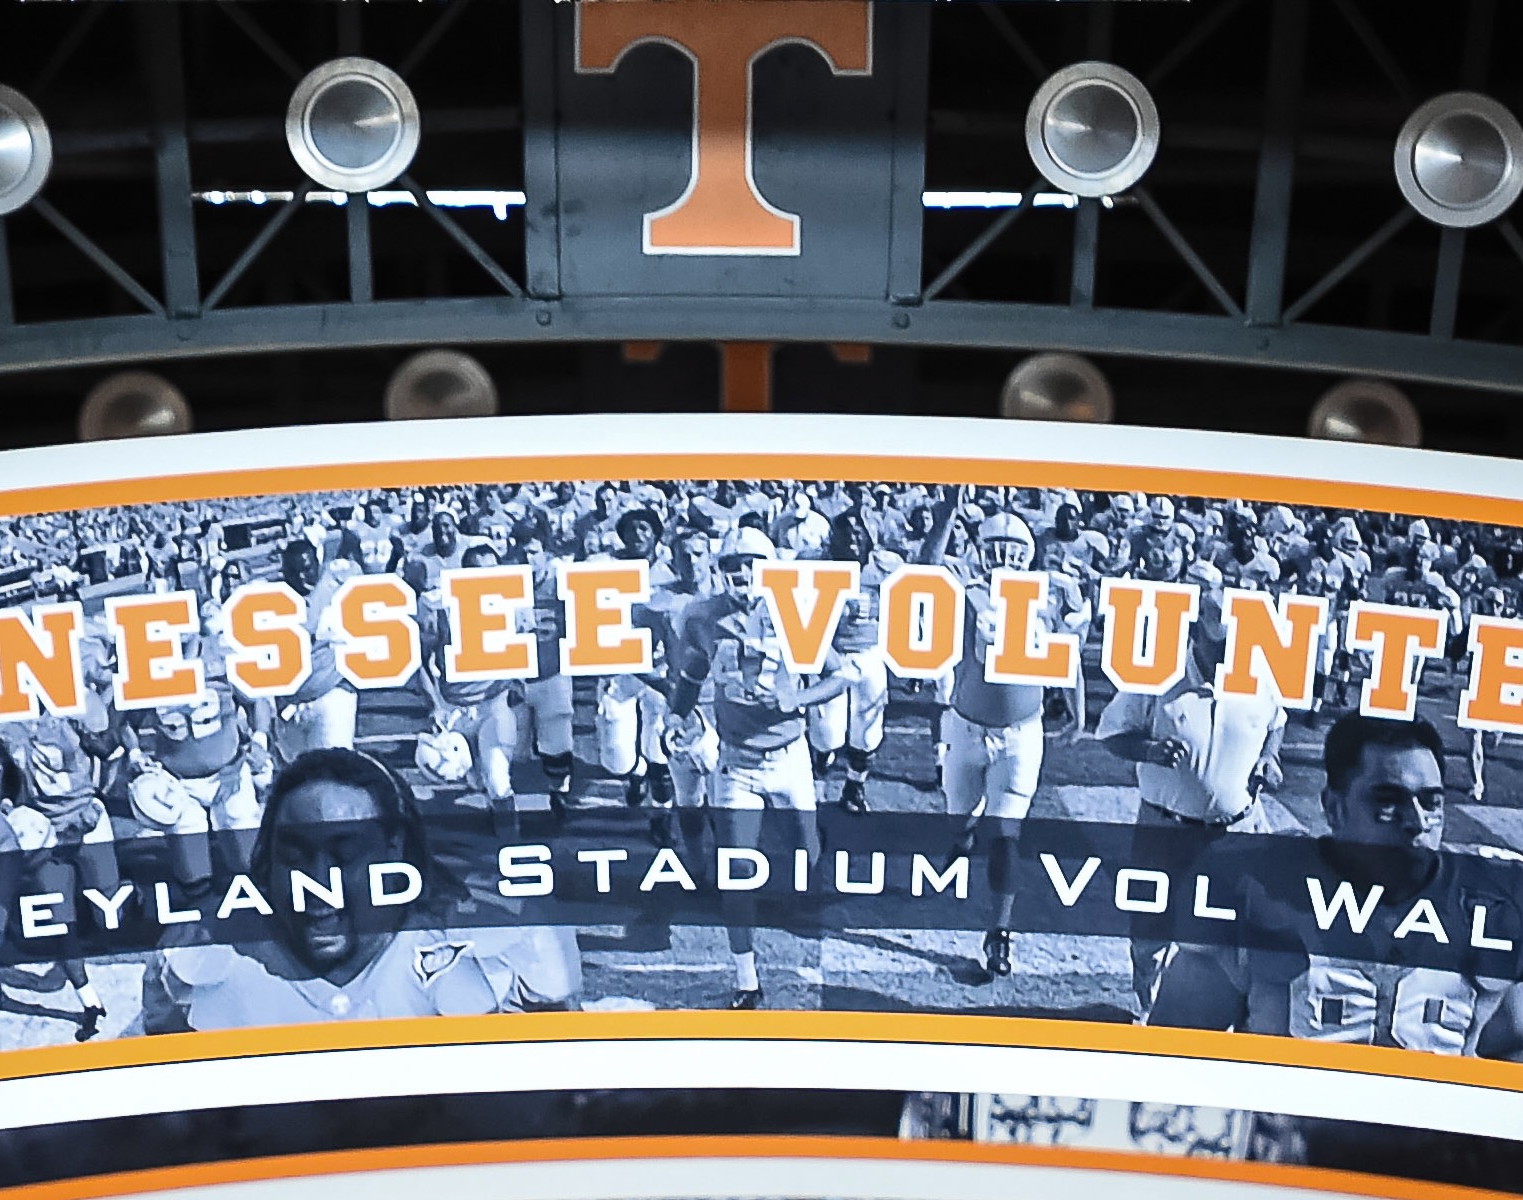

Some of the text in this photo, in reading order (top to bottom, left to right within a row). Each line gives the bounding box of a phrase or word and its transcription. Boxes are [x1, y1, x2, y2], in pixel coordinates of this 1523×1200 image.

[574, 0, 873, 256] T
[497, 843, 972, 900] STADIUM
[1038, 854, 1238, 923] VOL
